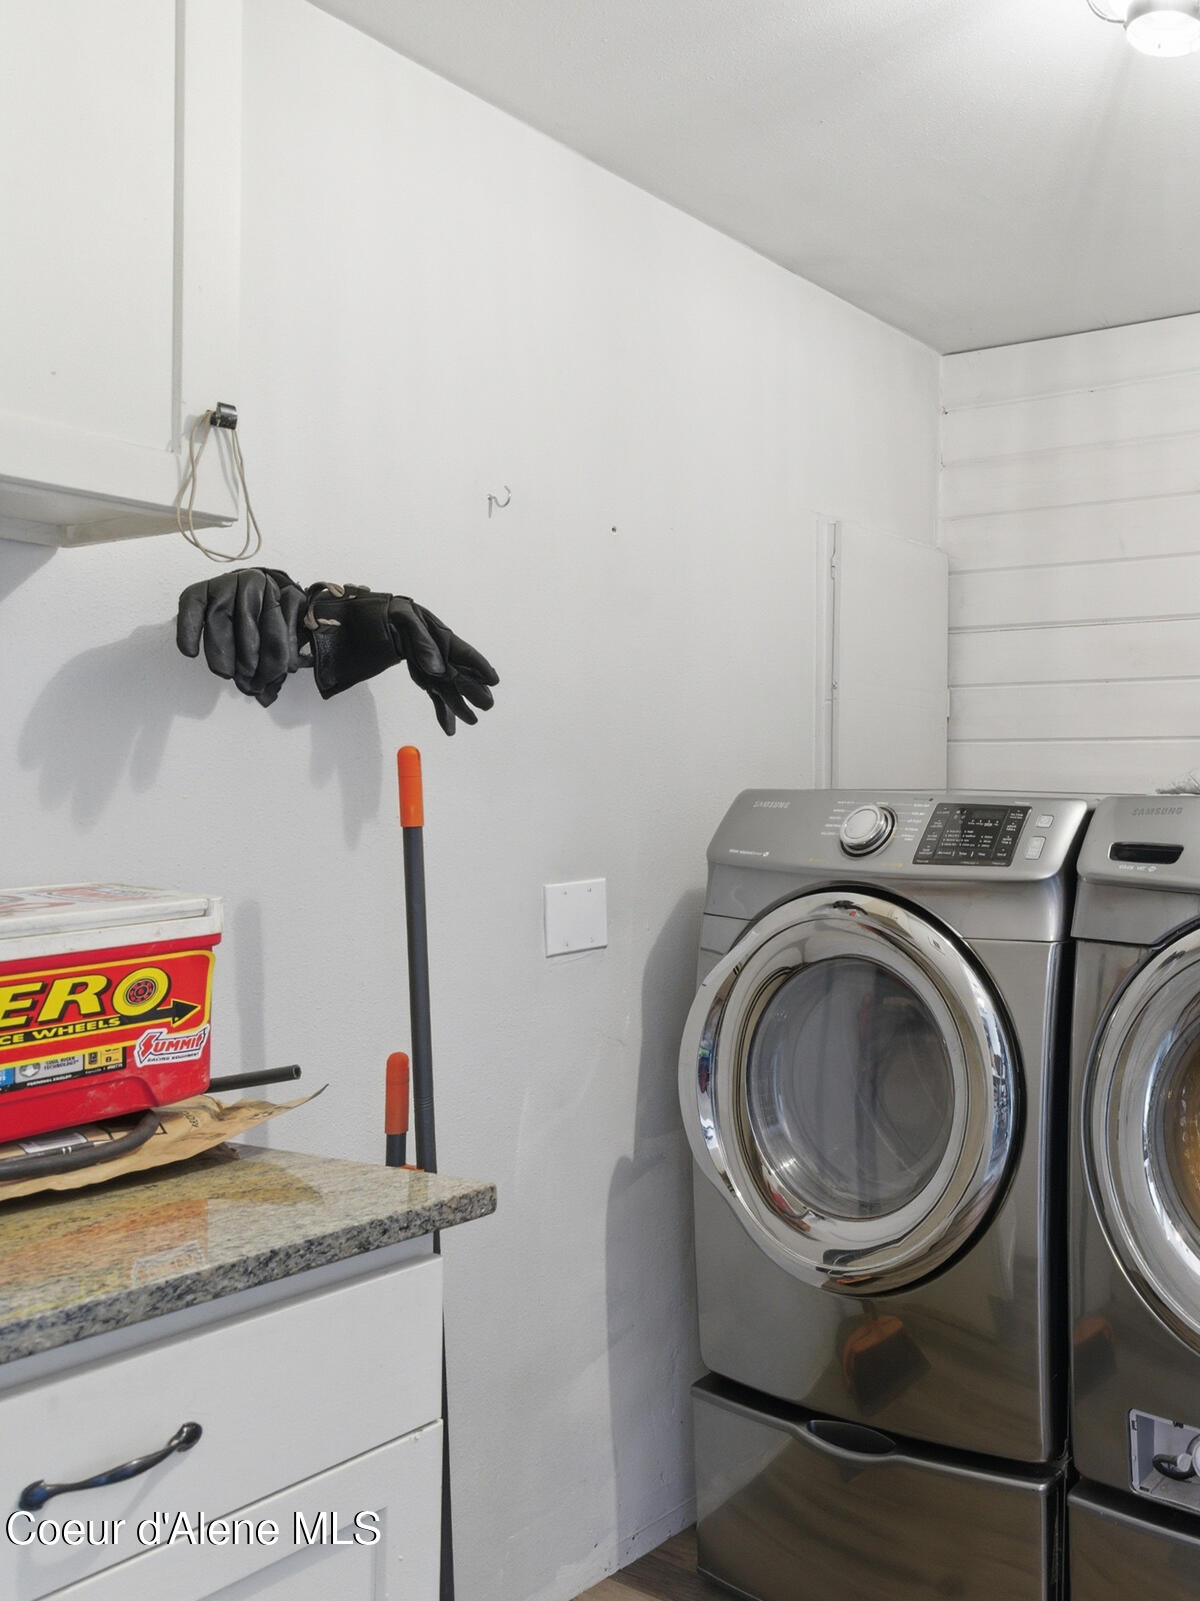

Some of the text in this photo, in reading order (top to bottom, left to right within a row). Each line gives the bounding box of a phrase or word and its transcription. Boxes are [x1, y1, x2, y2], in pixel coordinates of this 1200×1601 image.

[1131, 807, 1184, 816] SAMSUNG
[32, 1018, 121, 1040] WHEELS
[141, 1032, 203, 1058] SUMMIT
